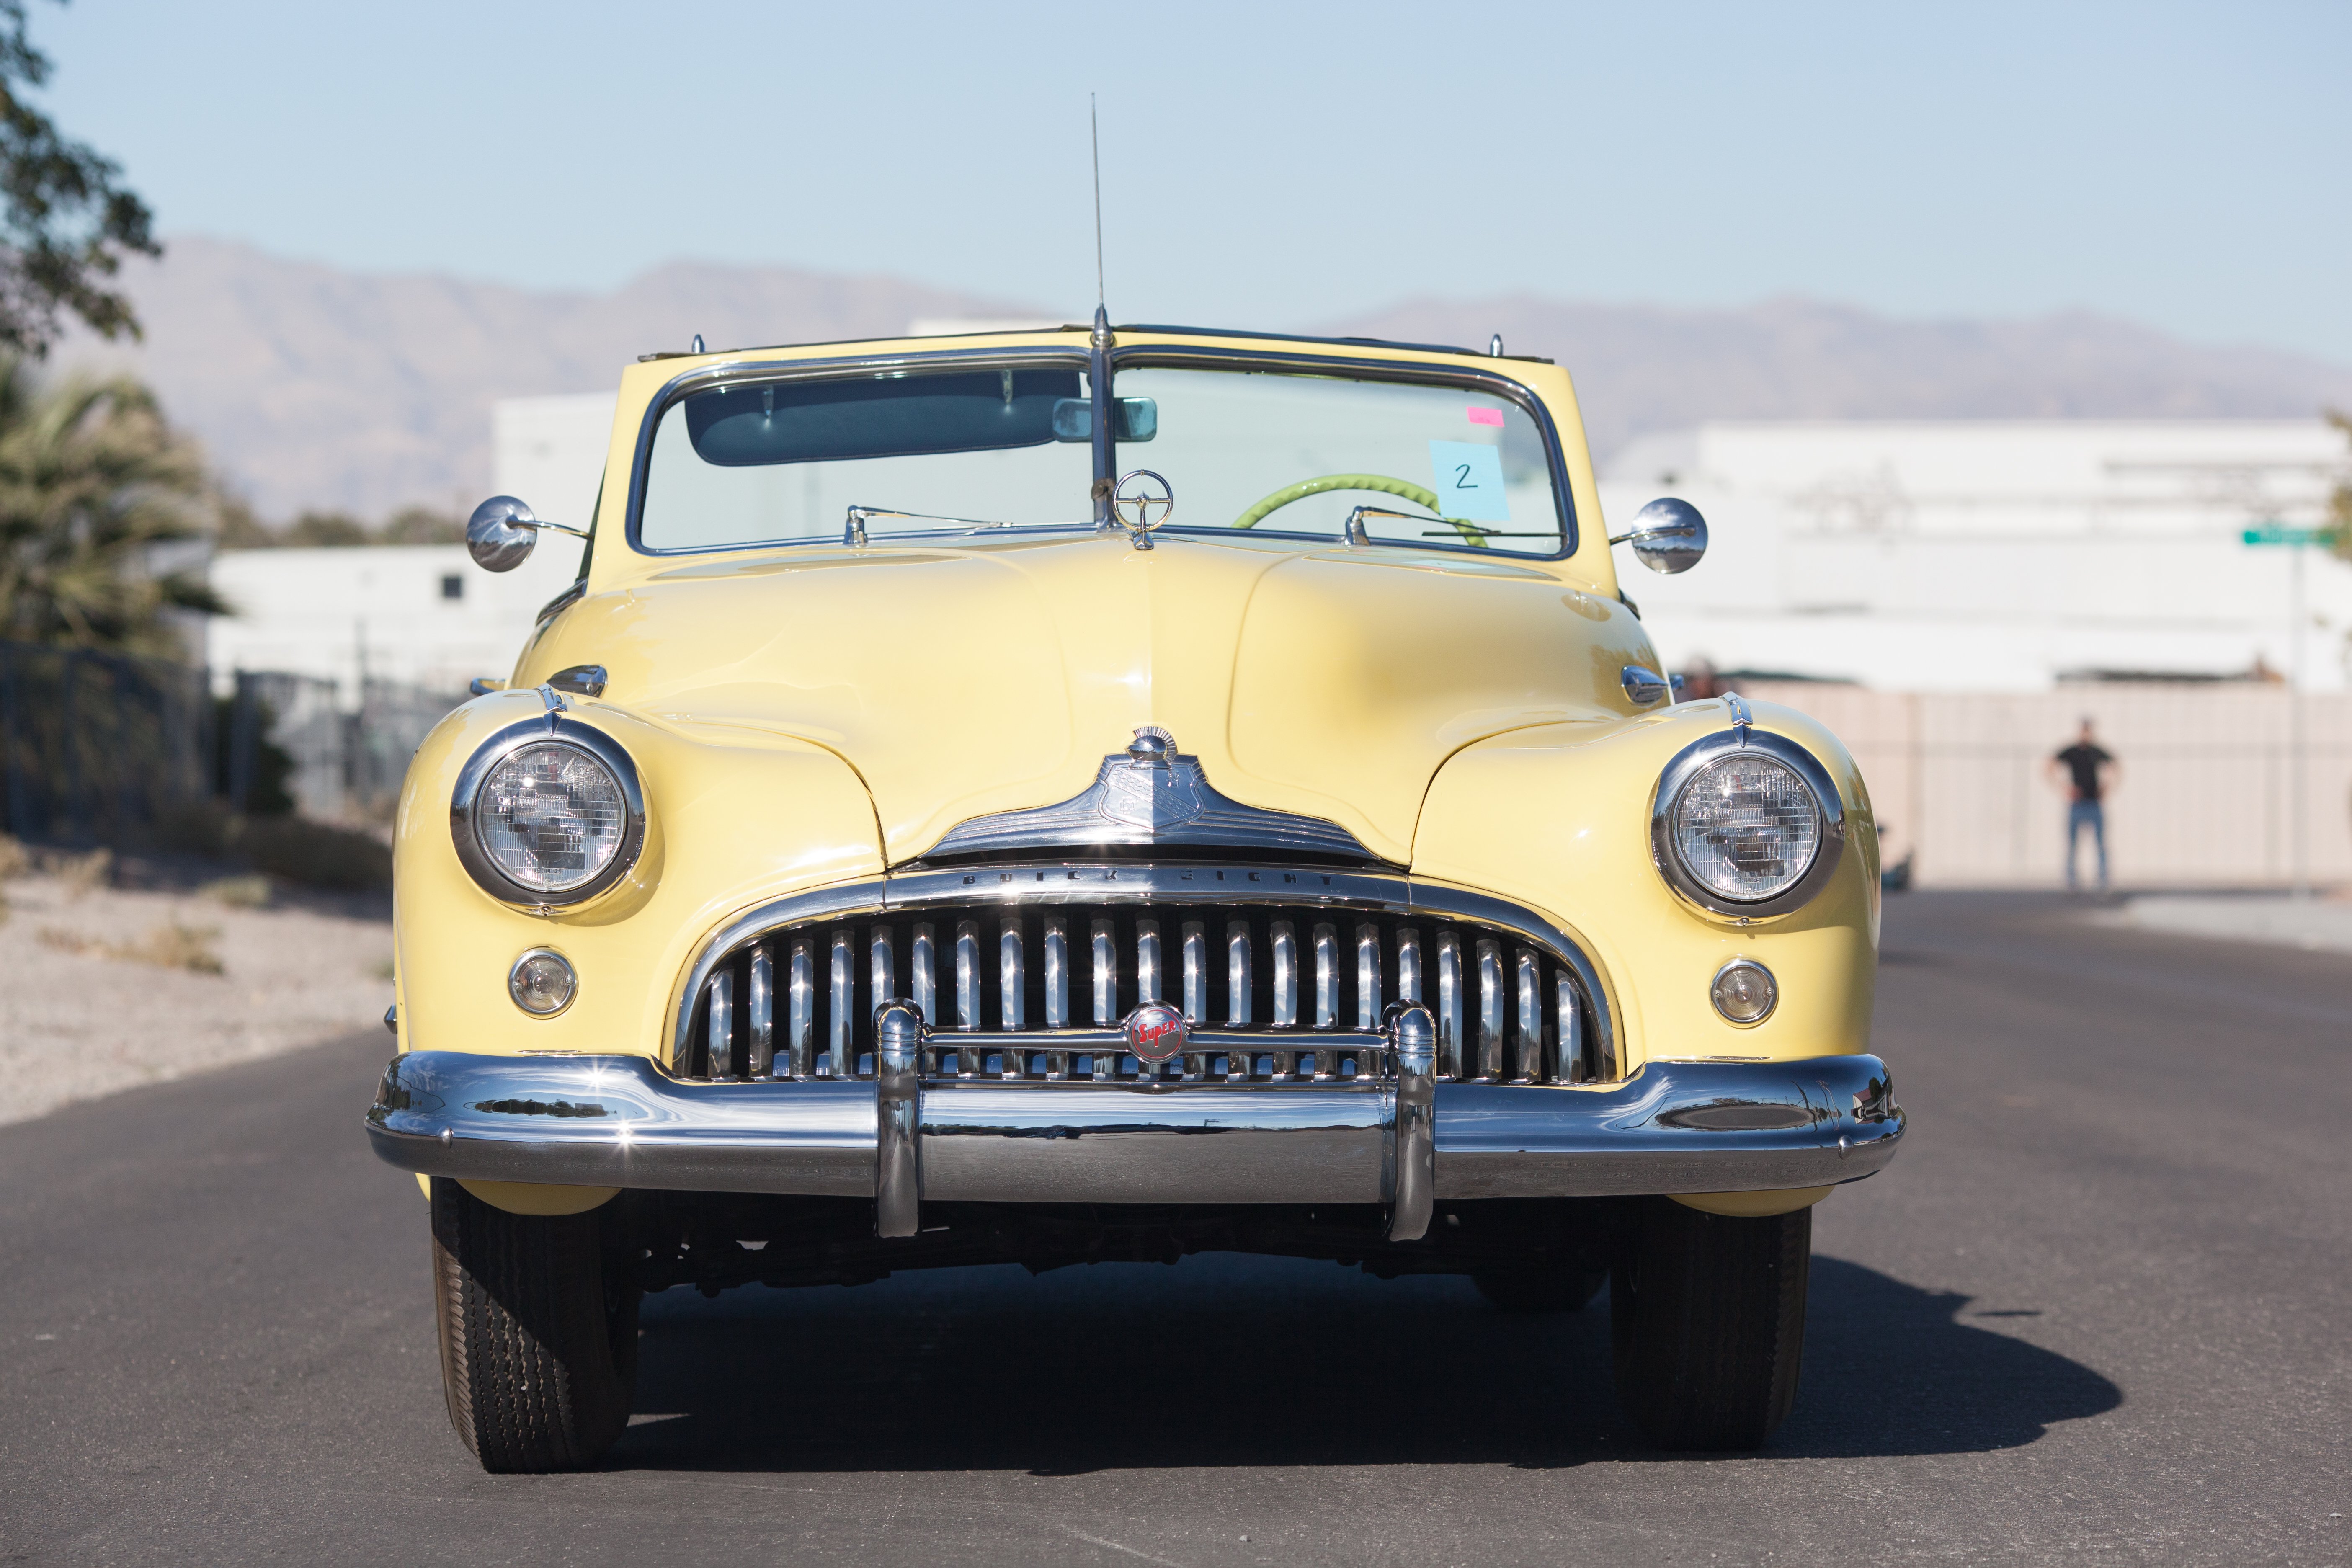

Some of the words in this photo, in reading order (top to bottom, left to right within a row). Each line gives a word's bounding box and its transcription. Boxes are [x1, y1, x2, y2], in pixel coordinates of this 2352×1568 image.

[1456, 464, 1478, 488] 2
[963, 870, 1117, 885] BUICK
[1181, 870, 1332, 885] EIGHT
[1138, 1020, 1176, 1048] SUPER
